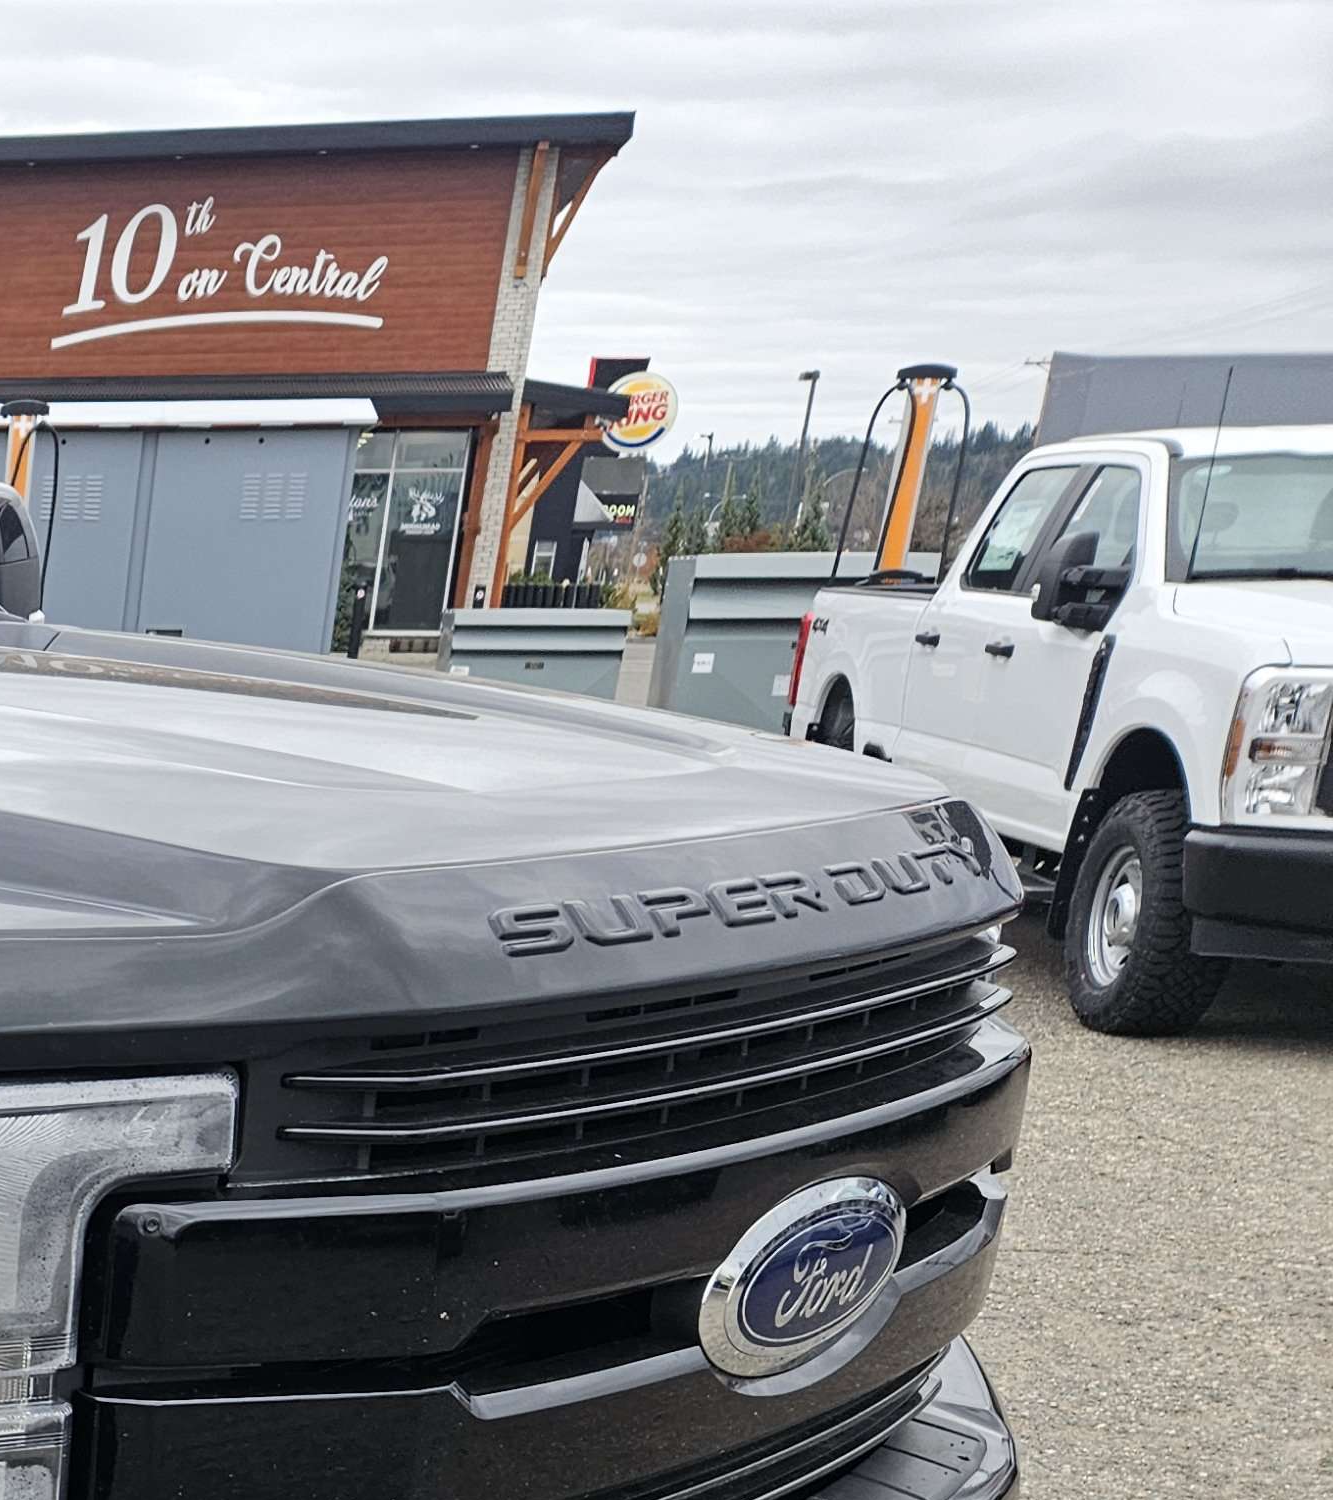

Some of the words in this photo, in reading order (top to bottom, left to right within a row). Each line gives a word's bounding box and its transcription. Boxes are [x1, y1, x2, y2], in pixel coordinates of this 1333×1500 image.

[177, 268, 228, 302] on
[233, 234, 389, 302] Central
[487, 870, 828, 957] SUPER
[823, 841, 982, 906] DUTY
[775, 1230, 874, 1328] Ford
